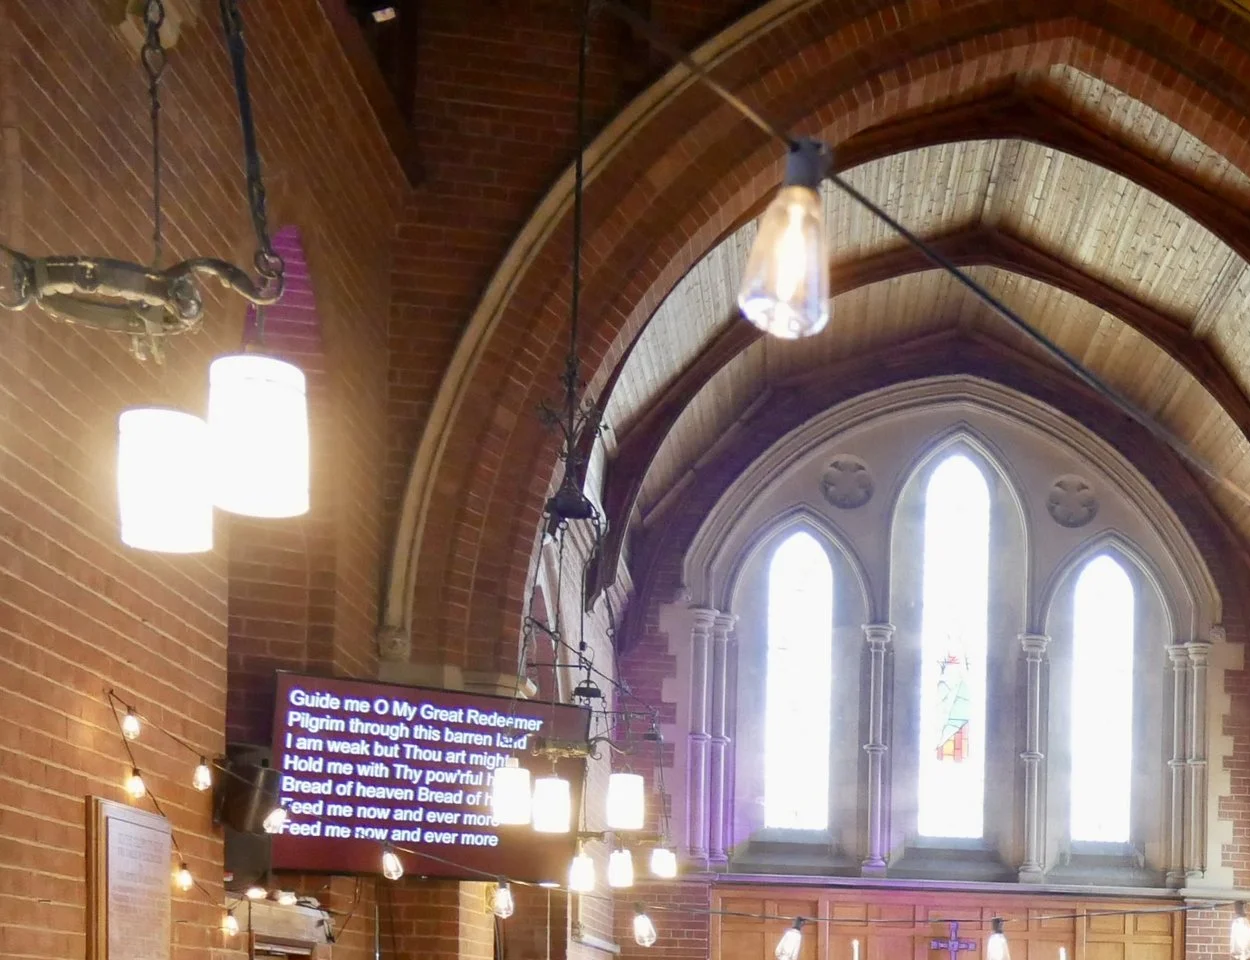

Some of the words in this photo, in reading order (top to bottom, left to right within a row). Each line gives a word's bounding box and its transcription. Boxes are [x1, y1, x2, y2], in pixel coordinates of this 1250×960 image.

[289, 689, 340, 710] Guide
[344, 699, 370, 713] me
[374, 699, 389, 715] O
[392, 701, 417, 721] My
[420, 704, 463, 724] Great
[466, 709, 543, 732] Redeemer
[287, 711, 345, 733] Pilgrim
[349, 718, 409, 741] through
[413, 725, 441, 741] this
[444, 727, 492, 746] barren
[285, 733, 292, 749] I
[296, 737, 323, 751] am
[327, 739, 370, 756] weak
[374, 741, 400, 758] but
[403, 744, 442, 762] Thou
[445, 750, 467, 764] art
[470, 752, 511, 770] might
[283, 754, 323, 773] Hold
[327, 761, 353, 775] me
[356, 762, 389, 778] with
[393, 764, 422, 784] Thy
[425, 768, 483, 786] pow'rful
[281, 776, 332, 795] Bread
[335, 781, 354, 796] of
[356, 782, 414, 800] heaven
[417, 787, 463, 804] Bread
[466, 792, 482, 806] of
[327, 804, 353, 818] me
[356, 806, 391, 820] now
[393, 807, 423, 823] and
[426, 811, 461, 824] ever
[278, 819, 321, 836] Feed
[325, 824, 351, 838] me
[391, 827, 421, 843] and
[424, 831, 458, 844] ever
[461, 833, 499, 847] more
